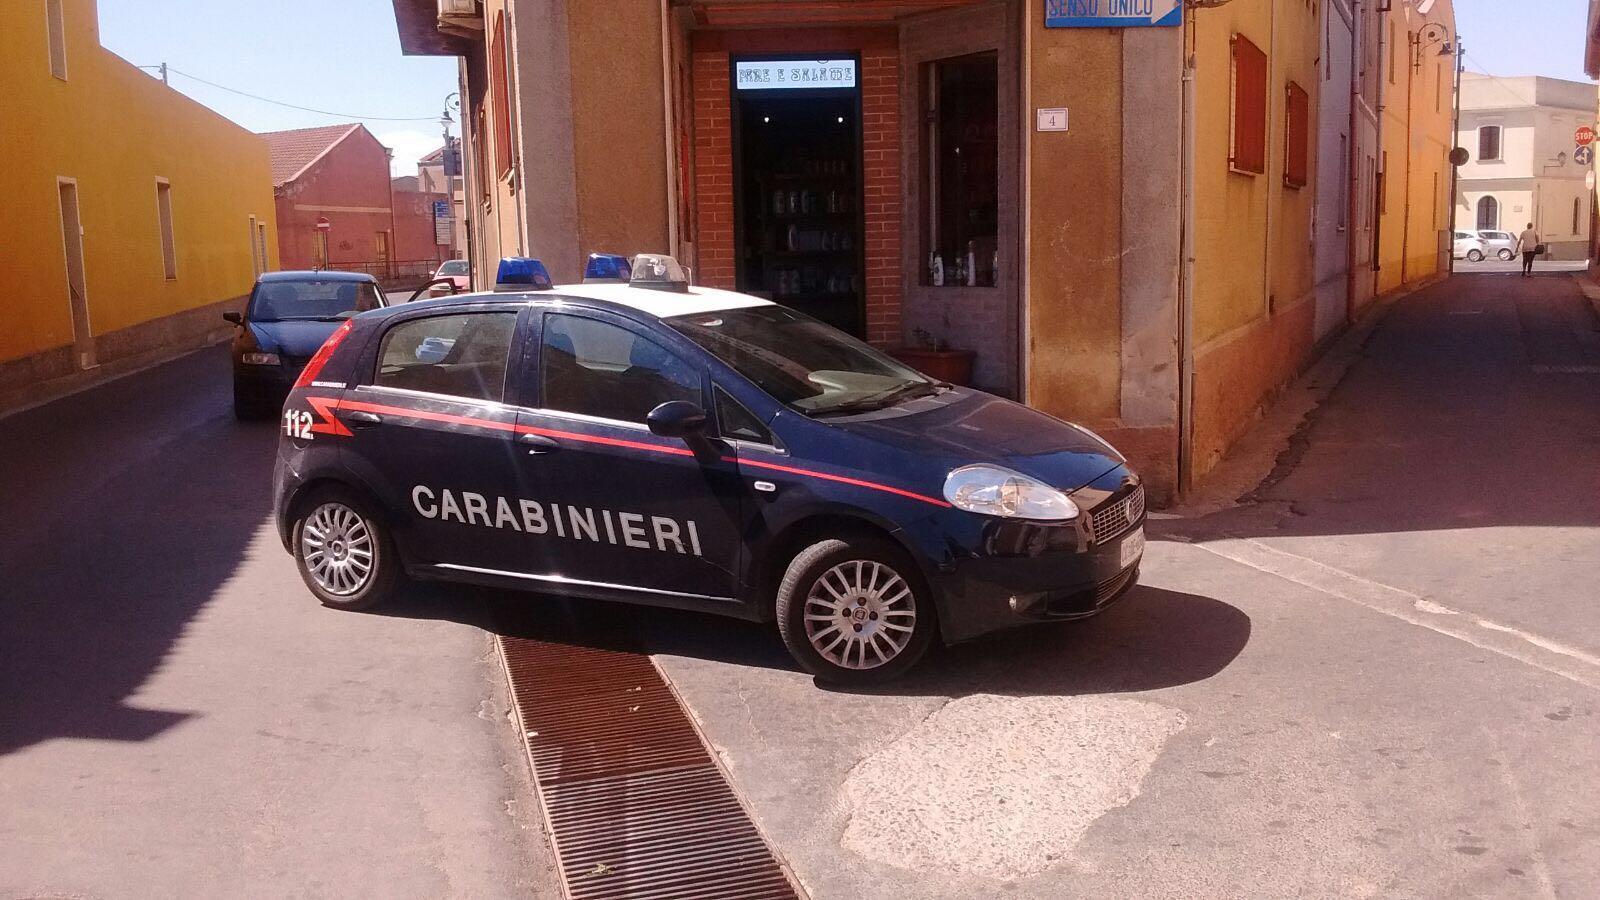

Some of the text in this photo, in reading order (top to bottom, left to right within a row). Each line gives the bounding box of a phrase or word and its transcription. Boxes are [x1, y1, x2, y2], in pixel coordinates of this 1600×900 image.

[1048, 0, 1153, 17] SENSO UNICO
[777, 68, 785, 82] E
[1049, 115, 1056, 127] 4
[1575, 132, 1593, 141] STOP
[284, 408, 314, 440] 112
[411, 484, 702, 556] CARABINIERI
